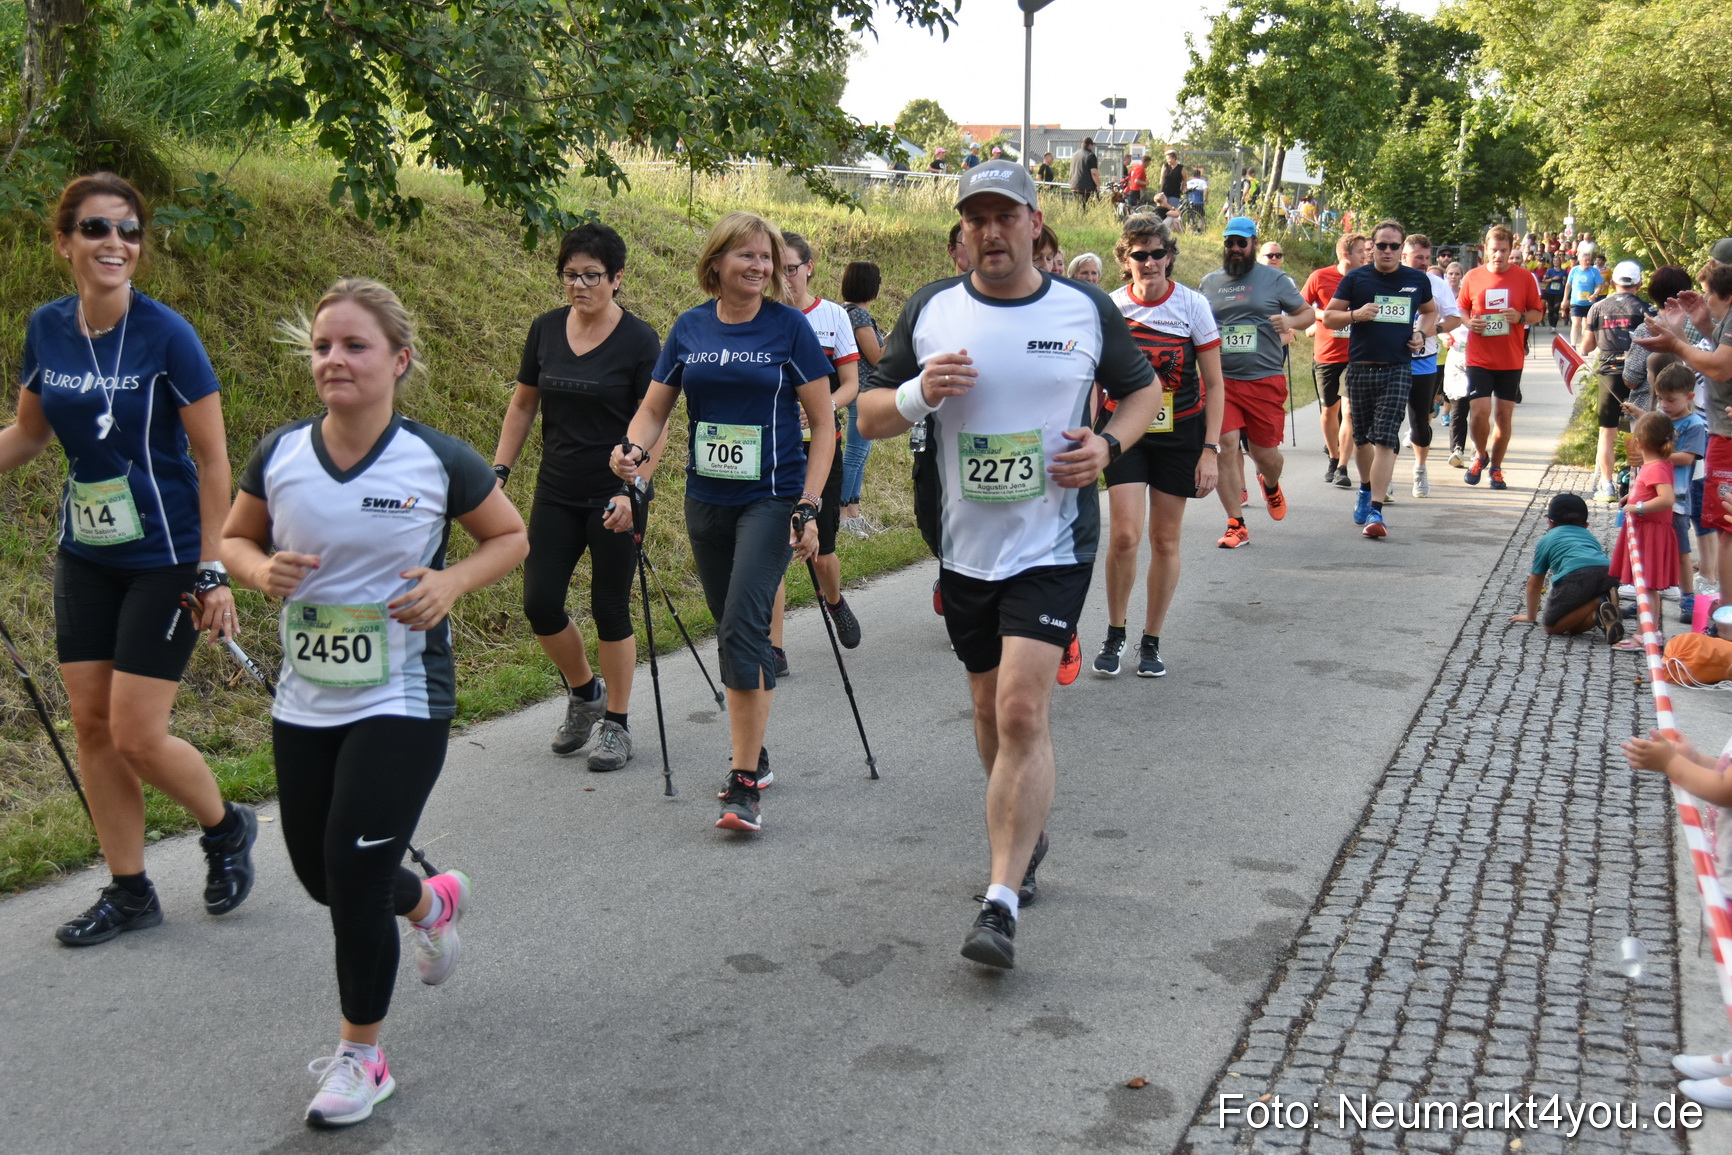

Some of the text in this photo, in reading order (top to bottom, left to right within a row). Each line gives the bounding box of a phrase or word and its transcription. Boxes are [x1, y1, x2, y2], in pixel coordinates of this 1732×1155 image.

[970, 170, 1000, 183] swn
[1379, 306, 1405, 315] 1383
[1027, 341, 1063, 350] swn
[1226, 335, 1252, 345] 1317
[685, 352, 772, 364] EURO POLES
[44, 369, 140, 389] EURO POLES
[706, 443, 743, 464] 706
[968, 456, 1033, 482] 2273
[362, 497, 401, 509] swn
[74, 502, 116, 528] 714
[1050, 618, 1067, 629] JAKO
[296, 632, 372, 664] 2450
